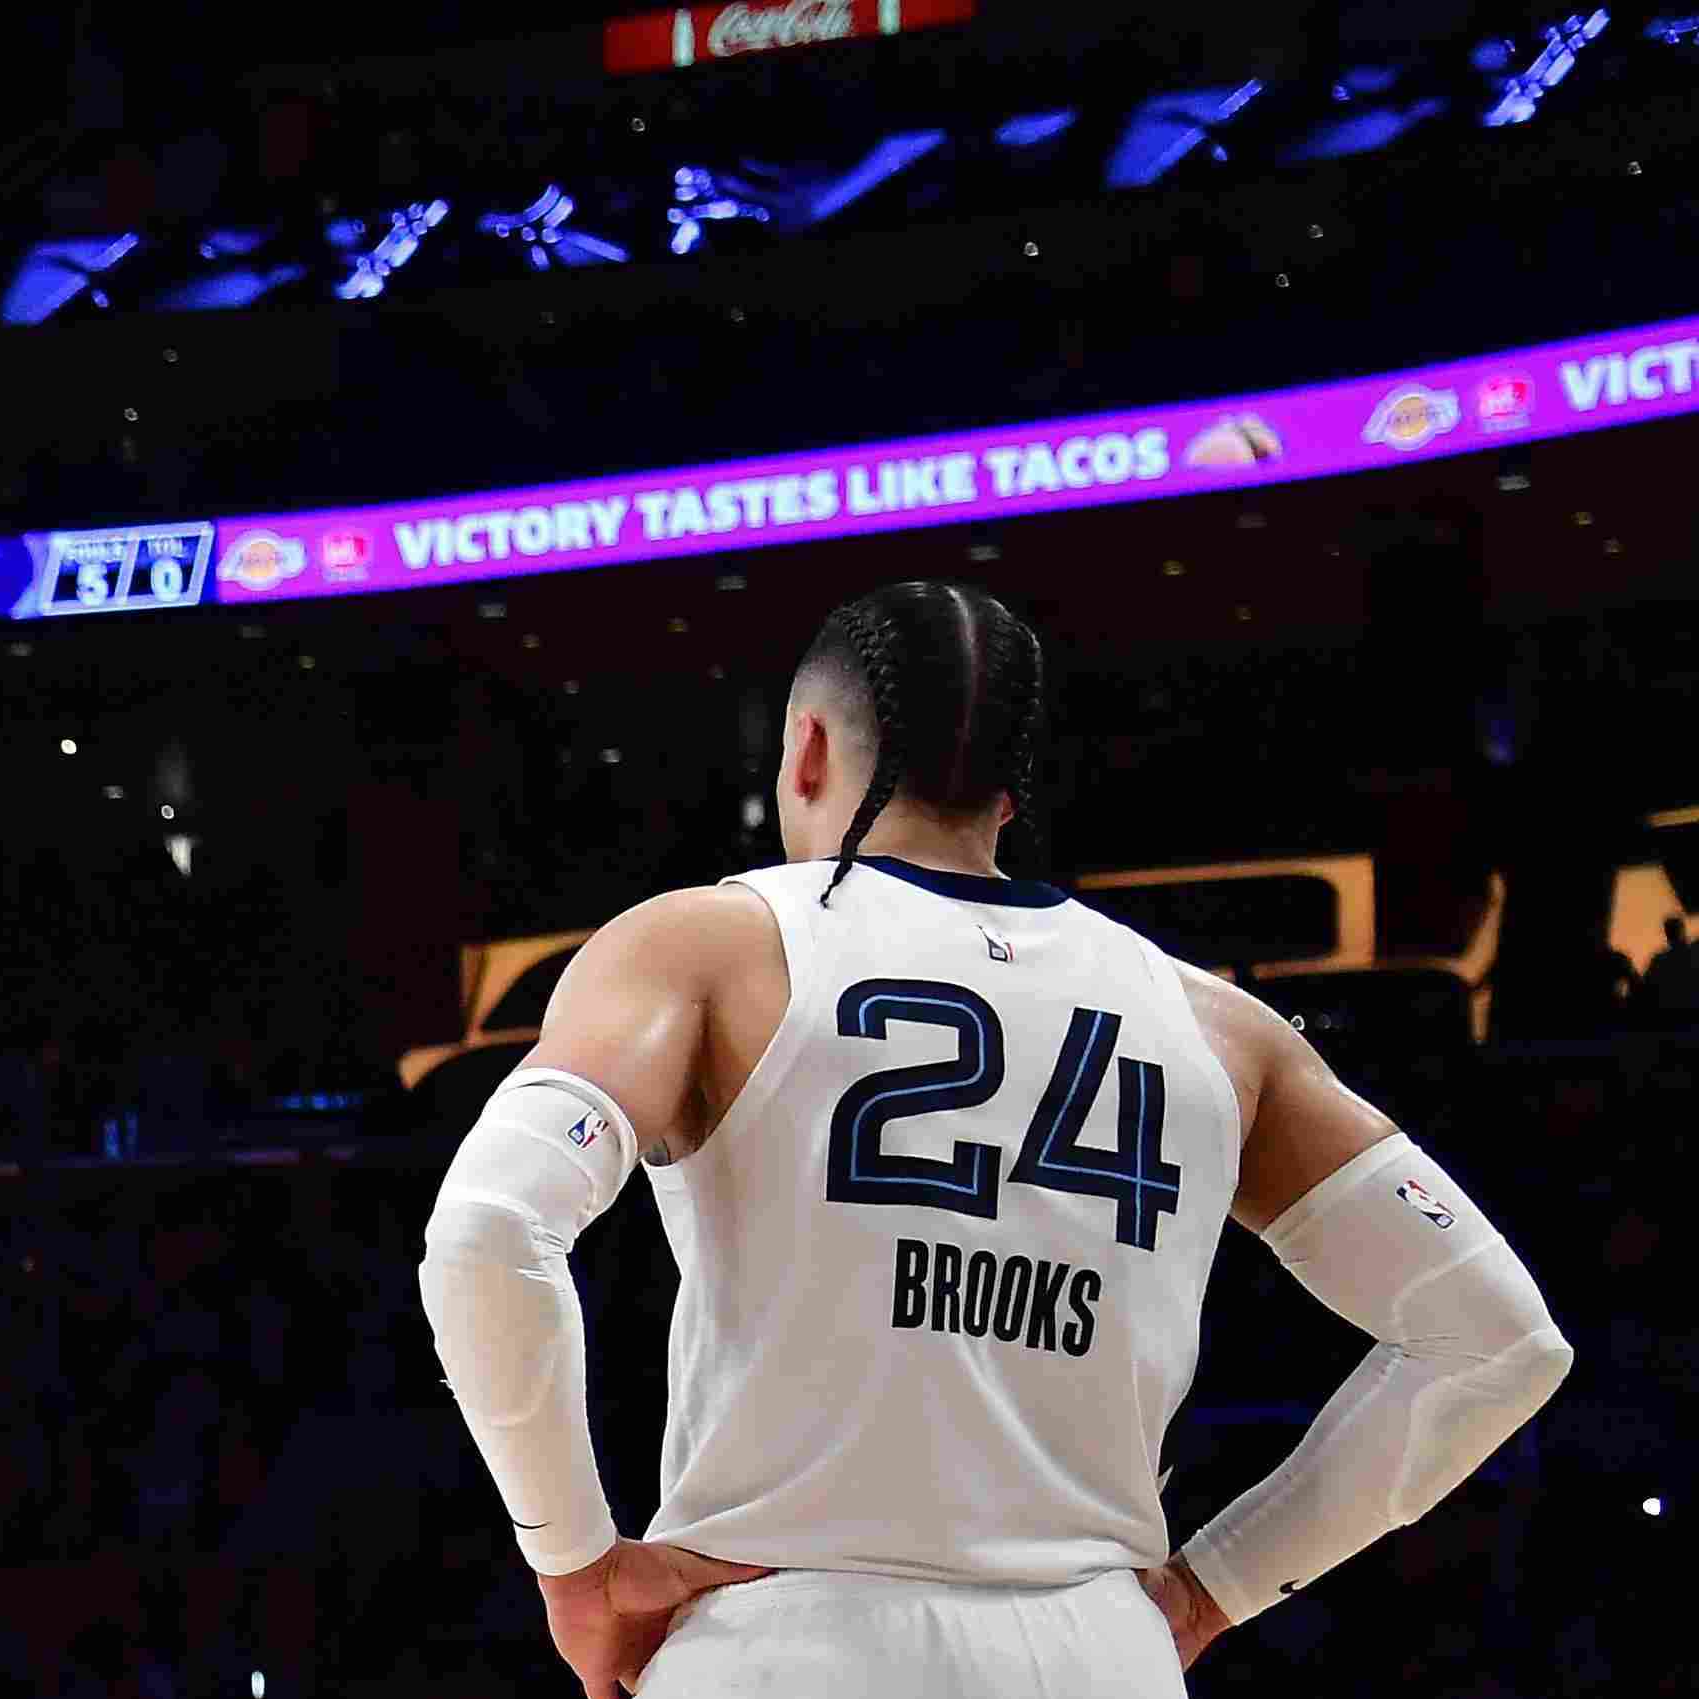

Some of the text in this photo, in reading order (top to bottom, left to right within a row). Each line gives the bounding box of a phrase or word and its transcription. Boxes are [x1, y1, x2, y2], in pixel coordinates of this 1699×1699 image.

[394, 500, 631, 569] VICTORY
[636, 469, 839, 540] TASTES
[845, 452, 979, 516] LIKE
[985, 428, 1170, 497] TACOS
[150, 557, 184, 603] 0
[826, 977, 1183, 1253] 24
[890, 1237, 1103, 1358] BROOKS
